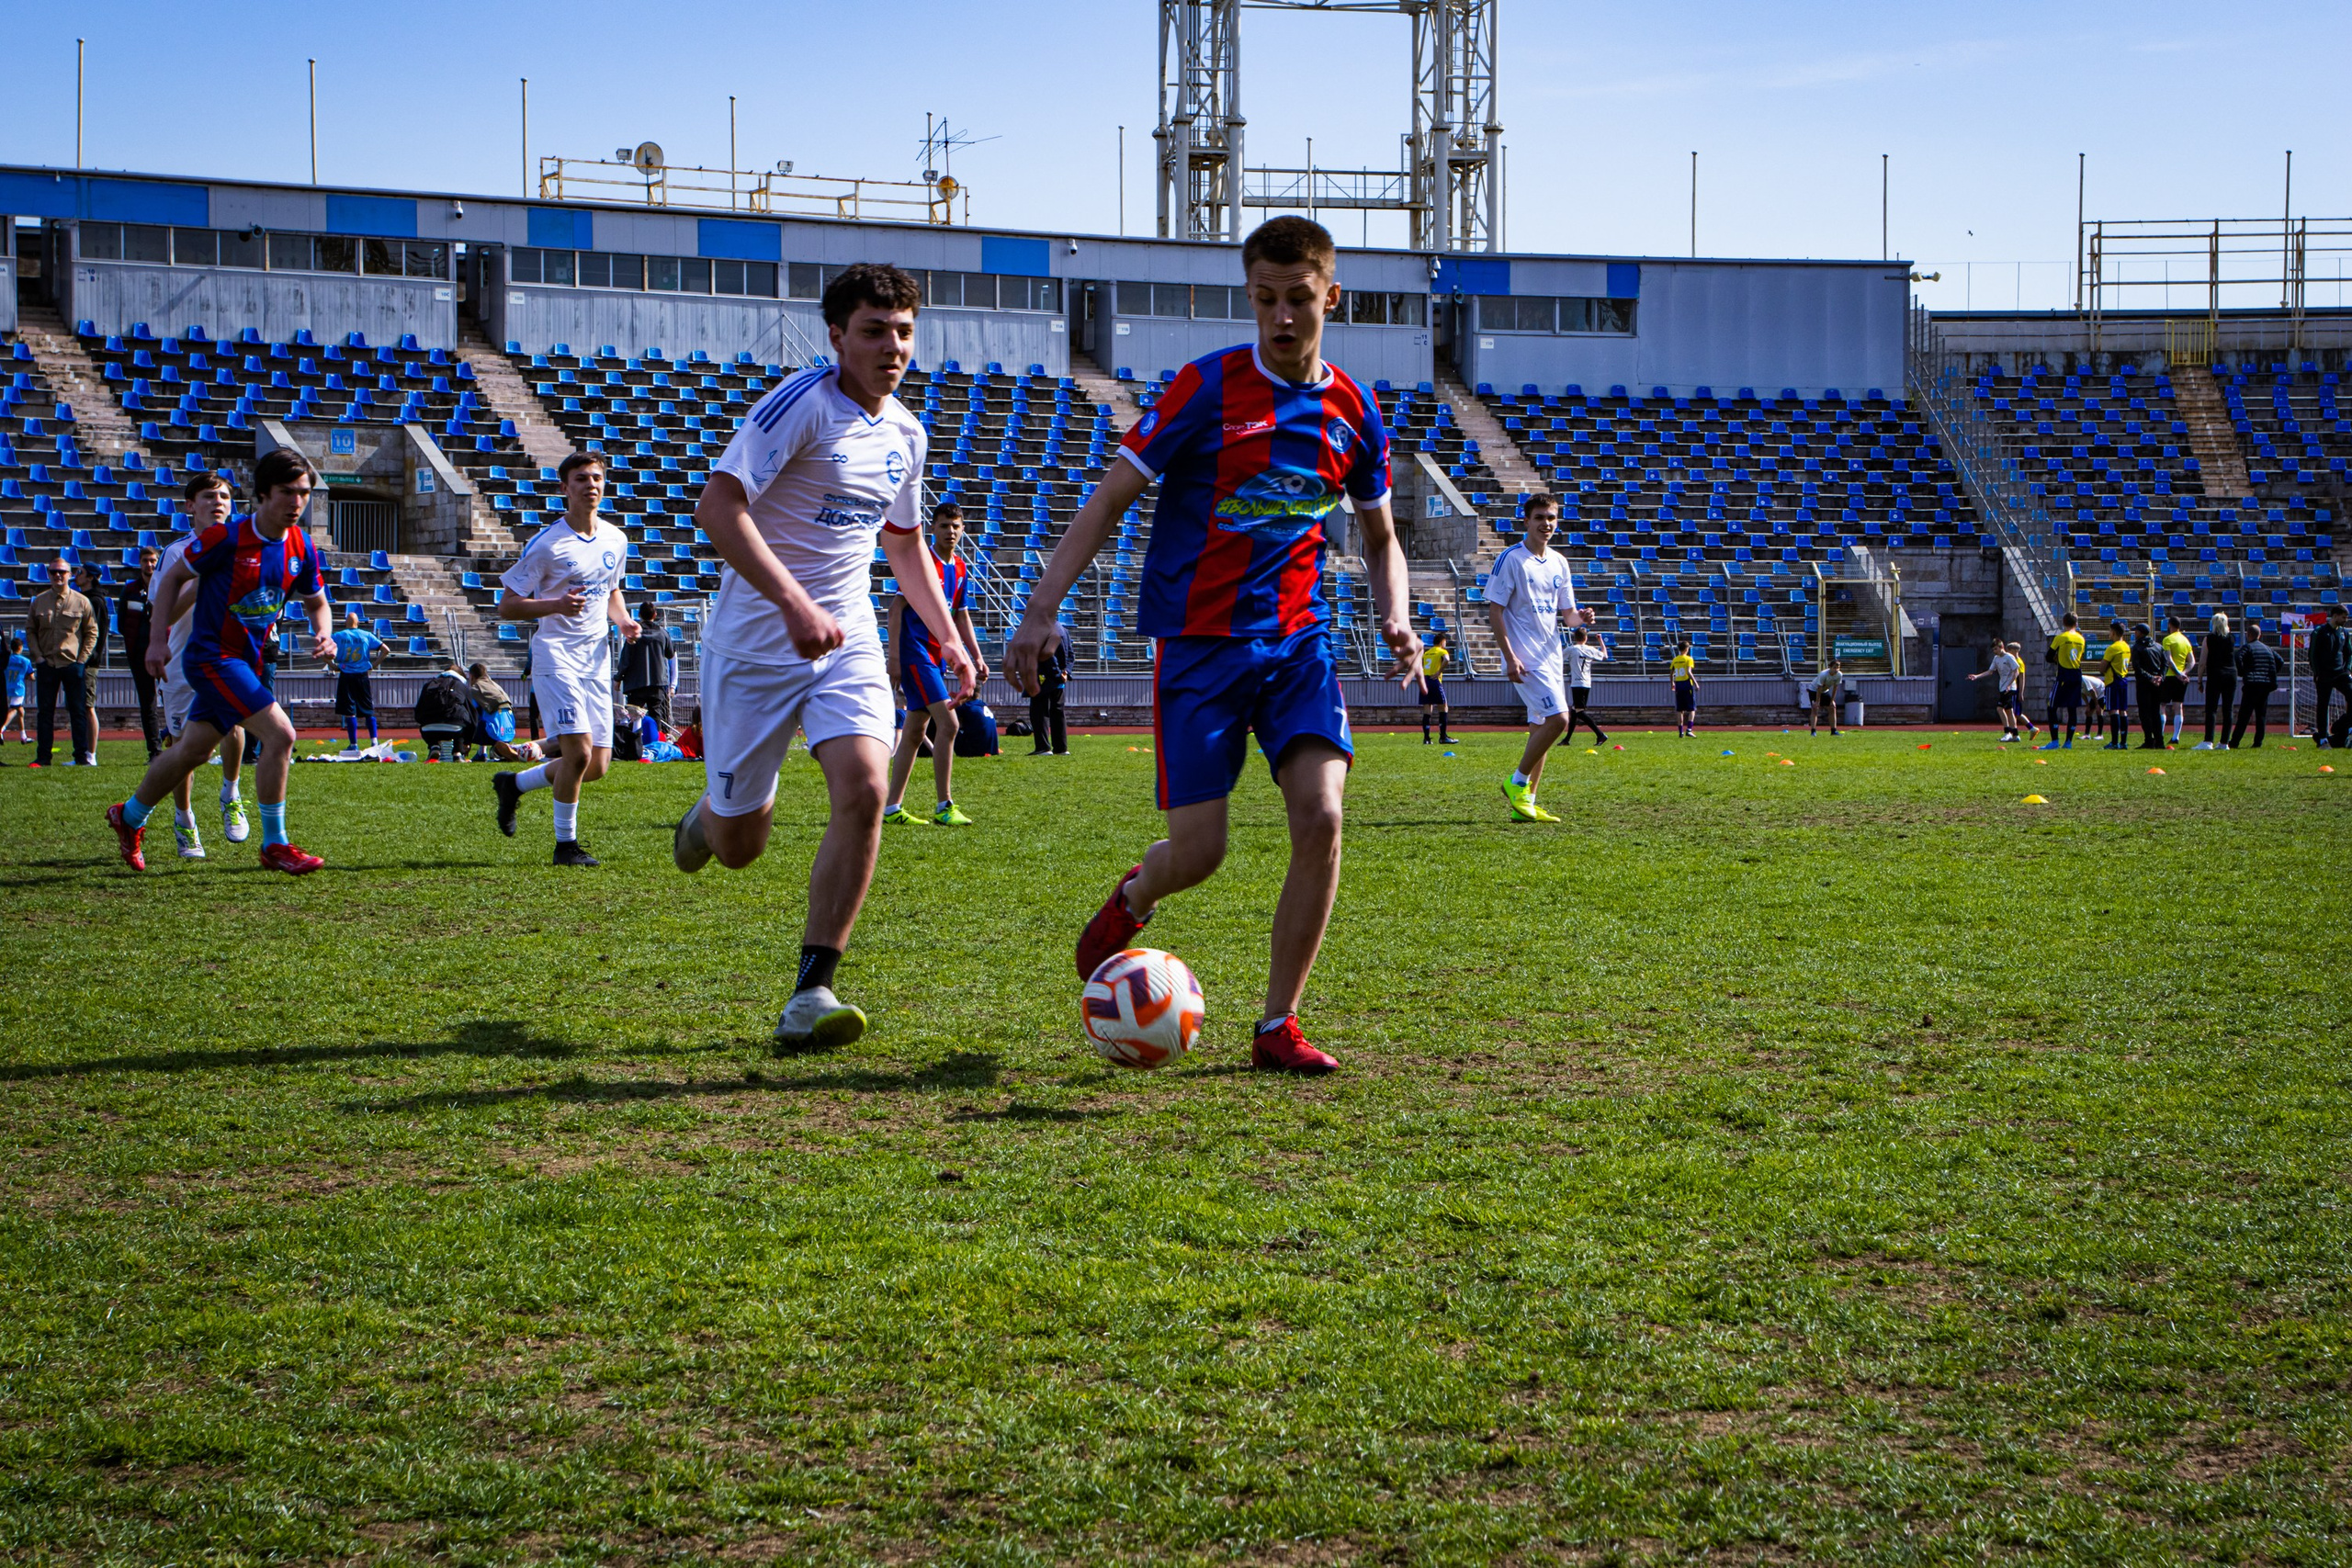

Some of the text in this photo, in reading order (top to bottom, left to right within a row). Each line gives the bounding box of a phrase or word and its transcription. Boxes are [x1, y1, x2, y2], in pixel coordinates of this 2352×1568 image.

[334, 434, 351, 446] 10
[345, 646, 362, 661] 16
[1425, 659, 1432, 669] 2
[1542, 696, 1554, 709] 11
[172, 716, 182, 730] 3
[558, 708, 576, 724] 10
[718, 771, 735, 799] 7
